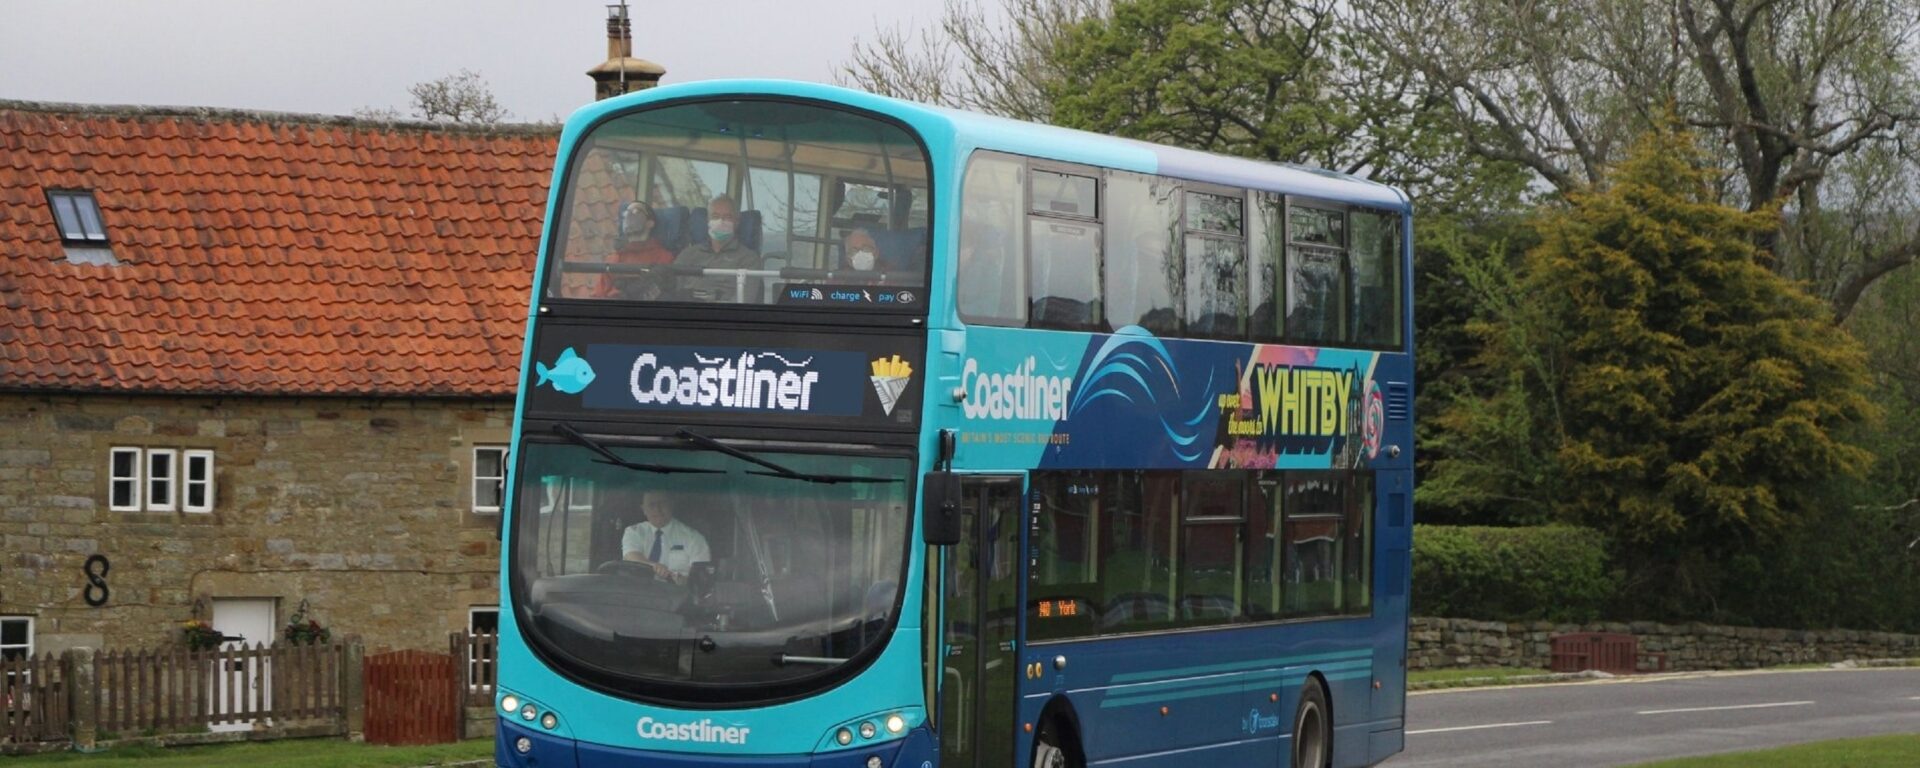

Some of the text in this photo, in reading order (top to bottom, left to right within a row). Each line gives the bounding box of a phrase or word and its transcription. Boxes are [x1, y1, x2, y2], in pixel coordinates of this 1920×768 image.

[790, 290, 895, 302] WiFi charge pay
[630, 351, 818, 411] Coastliner
[961, 355, 1071, 421] Coastliner
[1257, 366, 1353, 437] WHITBY
[636, 716, 750, 744] Coastliner
